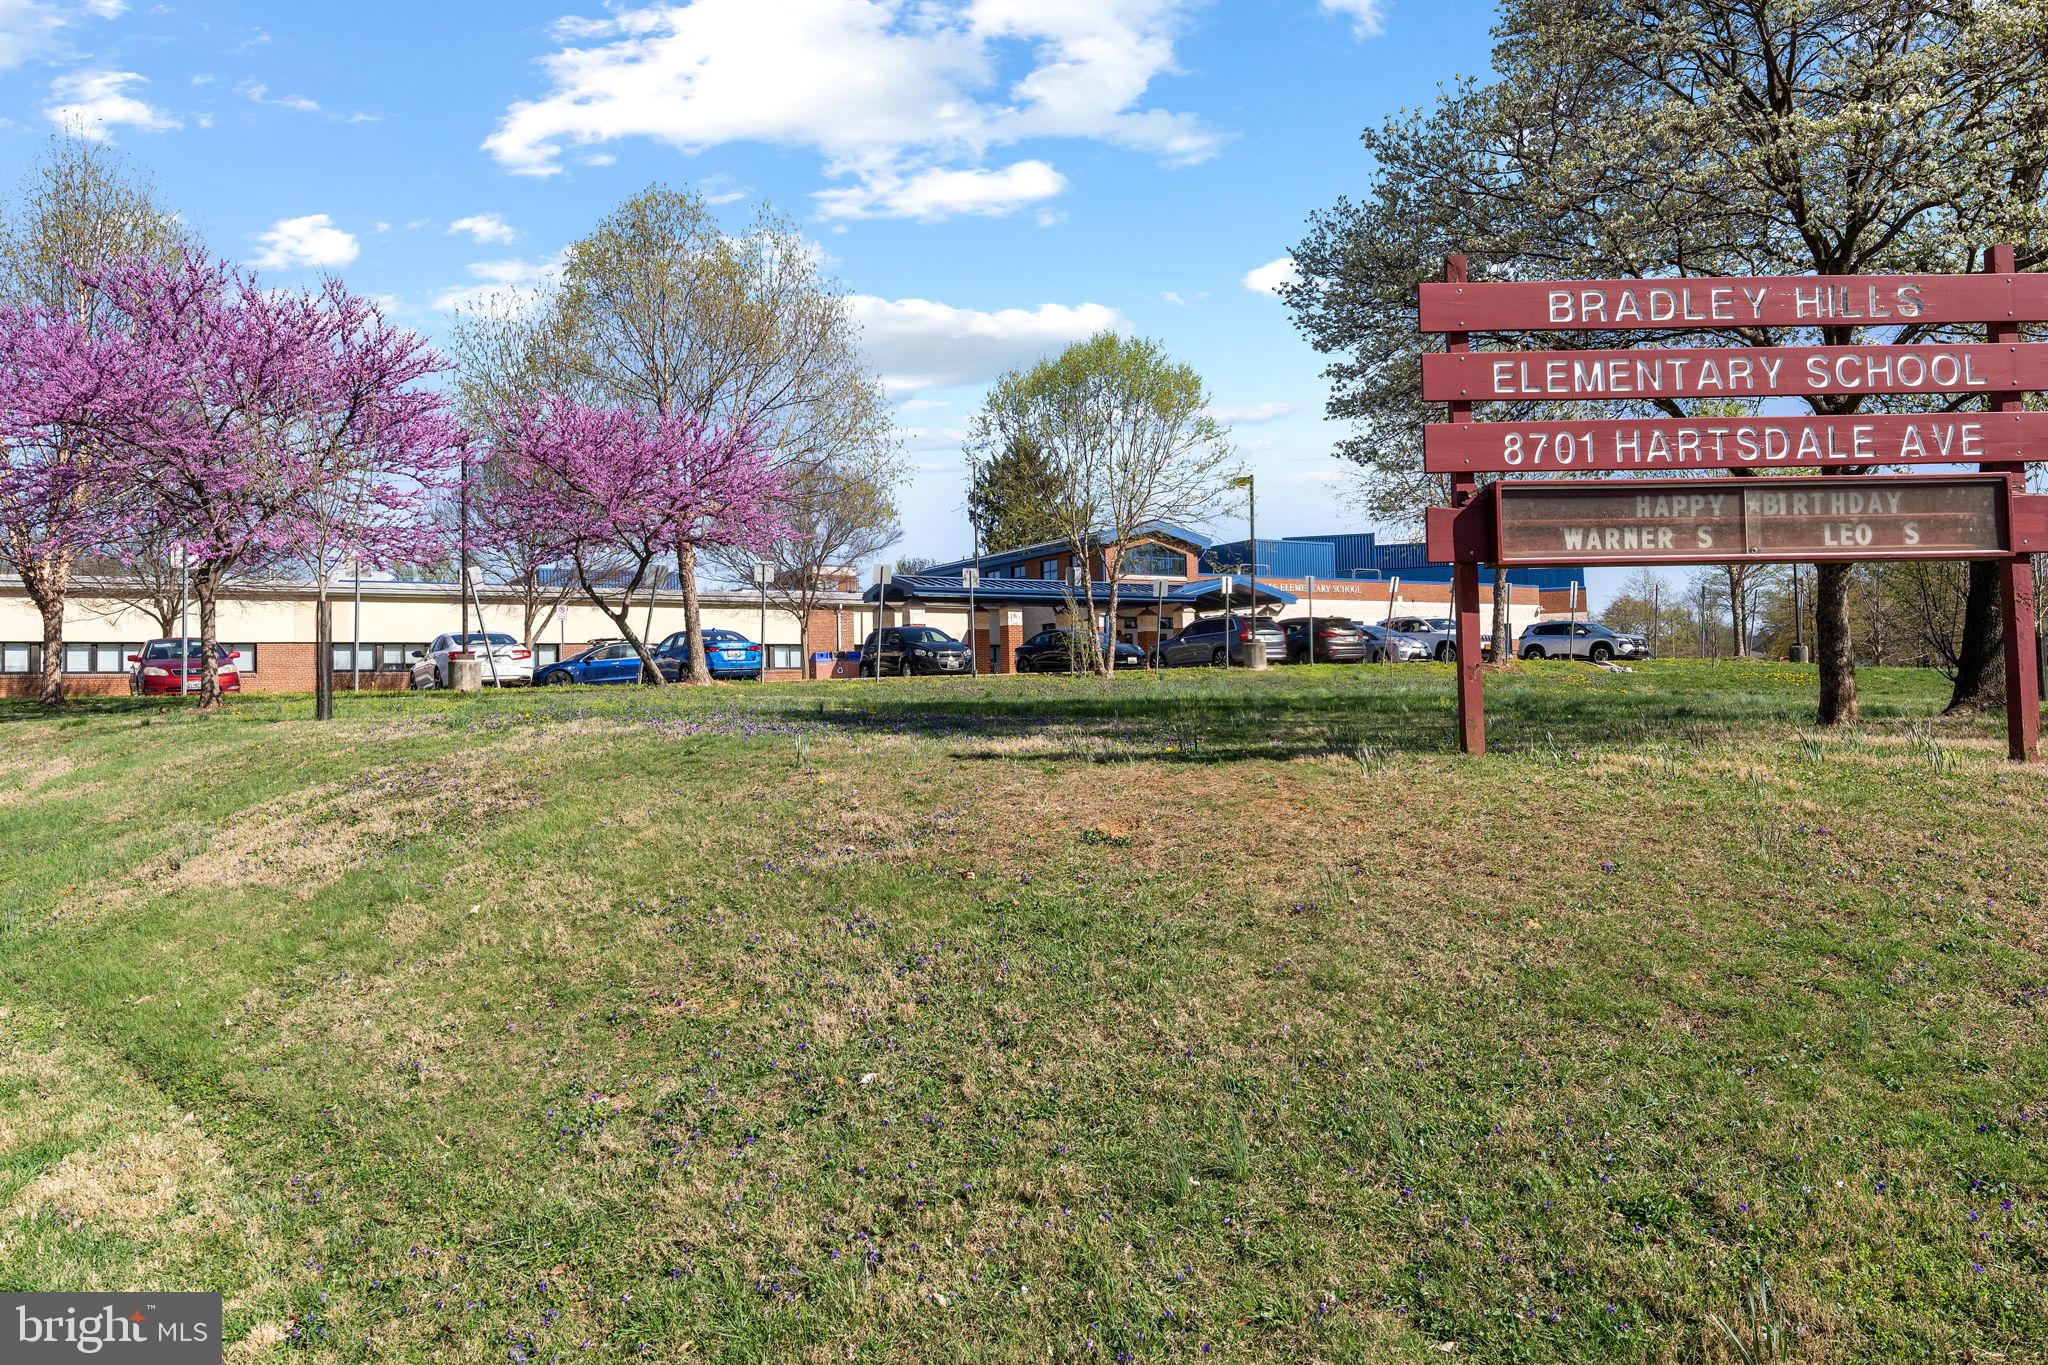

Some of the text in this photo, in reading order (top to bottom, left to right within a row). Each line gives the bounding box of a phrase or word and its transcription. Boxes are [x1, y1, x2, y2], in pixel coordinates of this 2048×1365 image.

[1548, 283, 1924, 323] BRADLEY HILLS
[1493, 352, 1988, 393] ELEMENTARY SCHOOL
[1503, 422, 1985, 465] 8701 HARTSDALE AVE
[1636, 491, 1901, 517] HAPPY BIRTHDAY
[1563, 522, 1921, 550] WARNER S LEO S
[1333, 584, 1361, 594] SCHOOL
